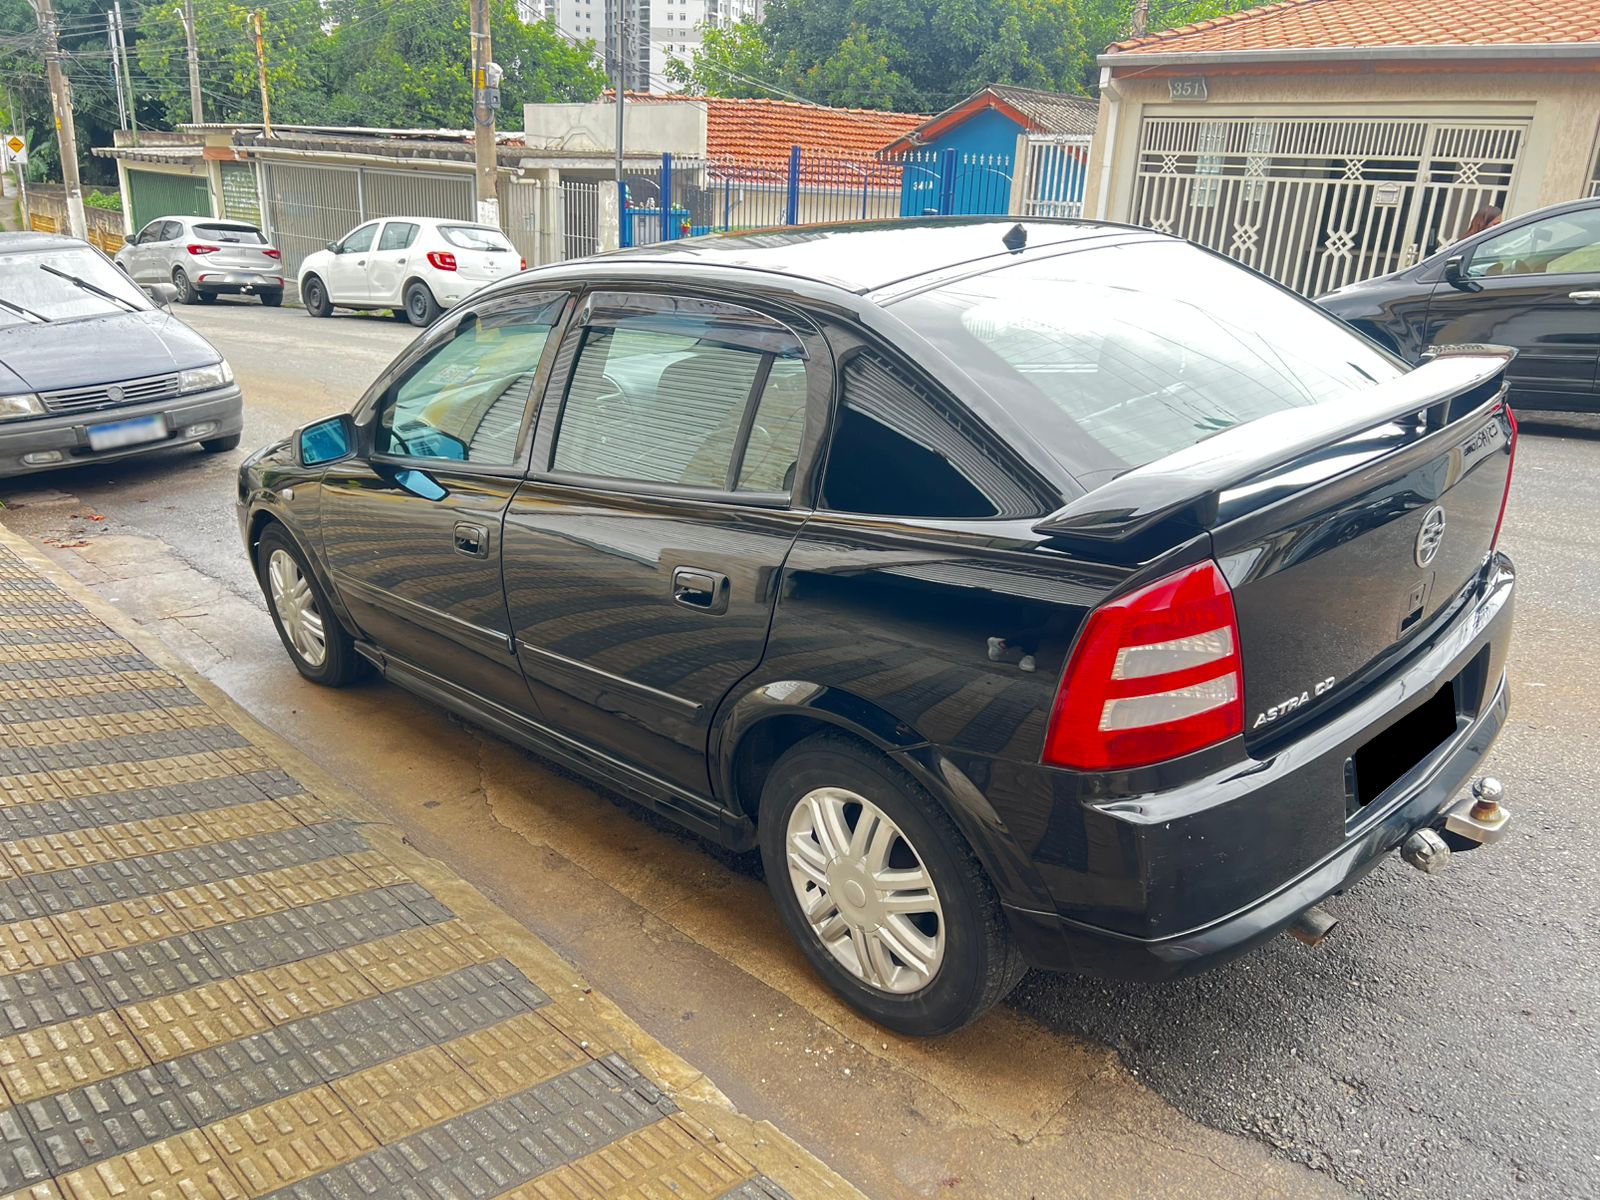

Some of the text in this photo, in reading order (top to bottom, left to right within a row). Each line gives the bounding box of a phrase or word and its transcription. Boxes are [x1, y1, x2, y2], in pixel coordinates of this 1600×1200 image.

[1173, 81, 1199, 96] 351
[1252, 676, 1336, 729] ASTRA CD
